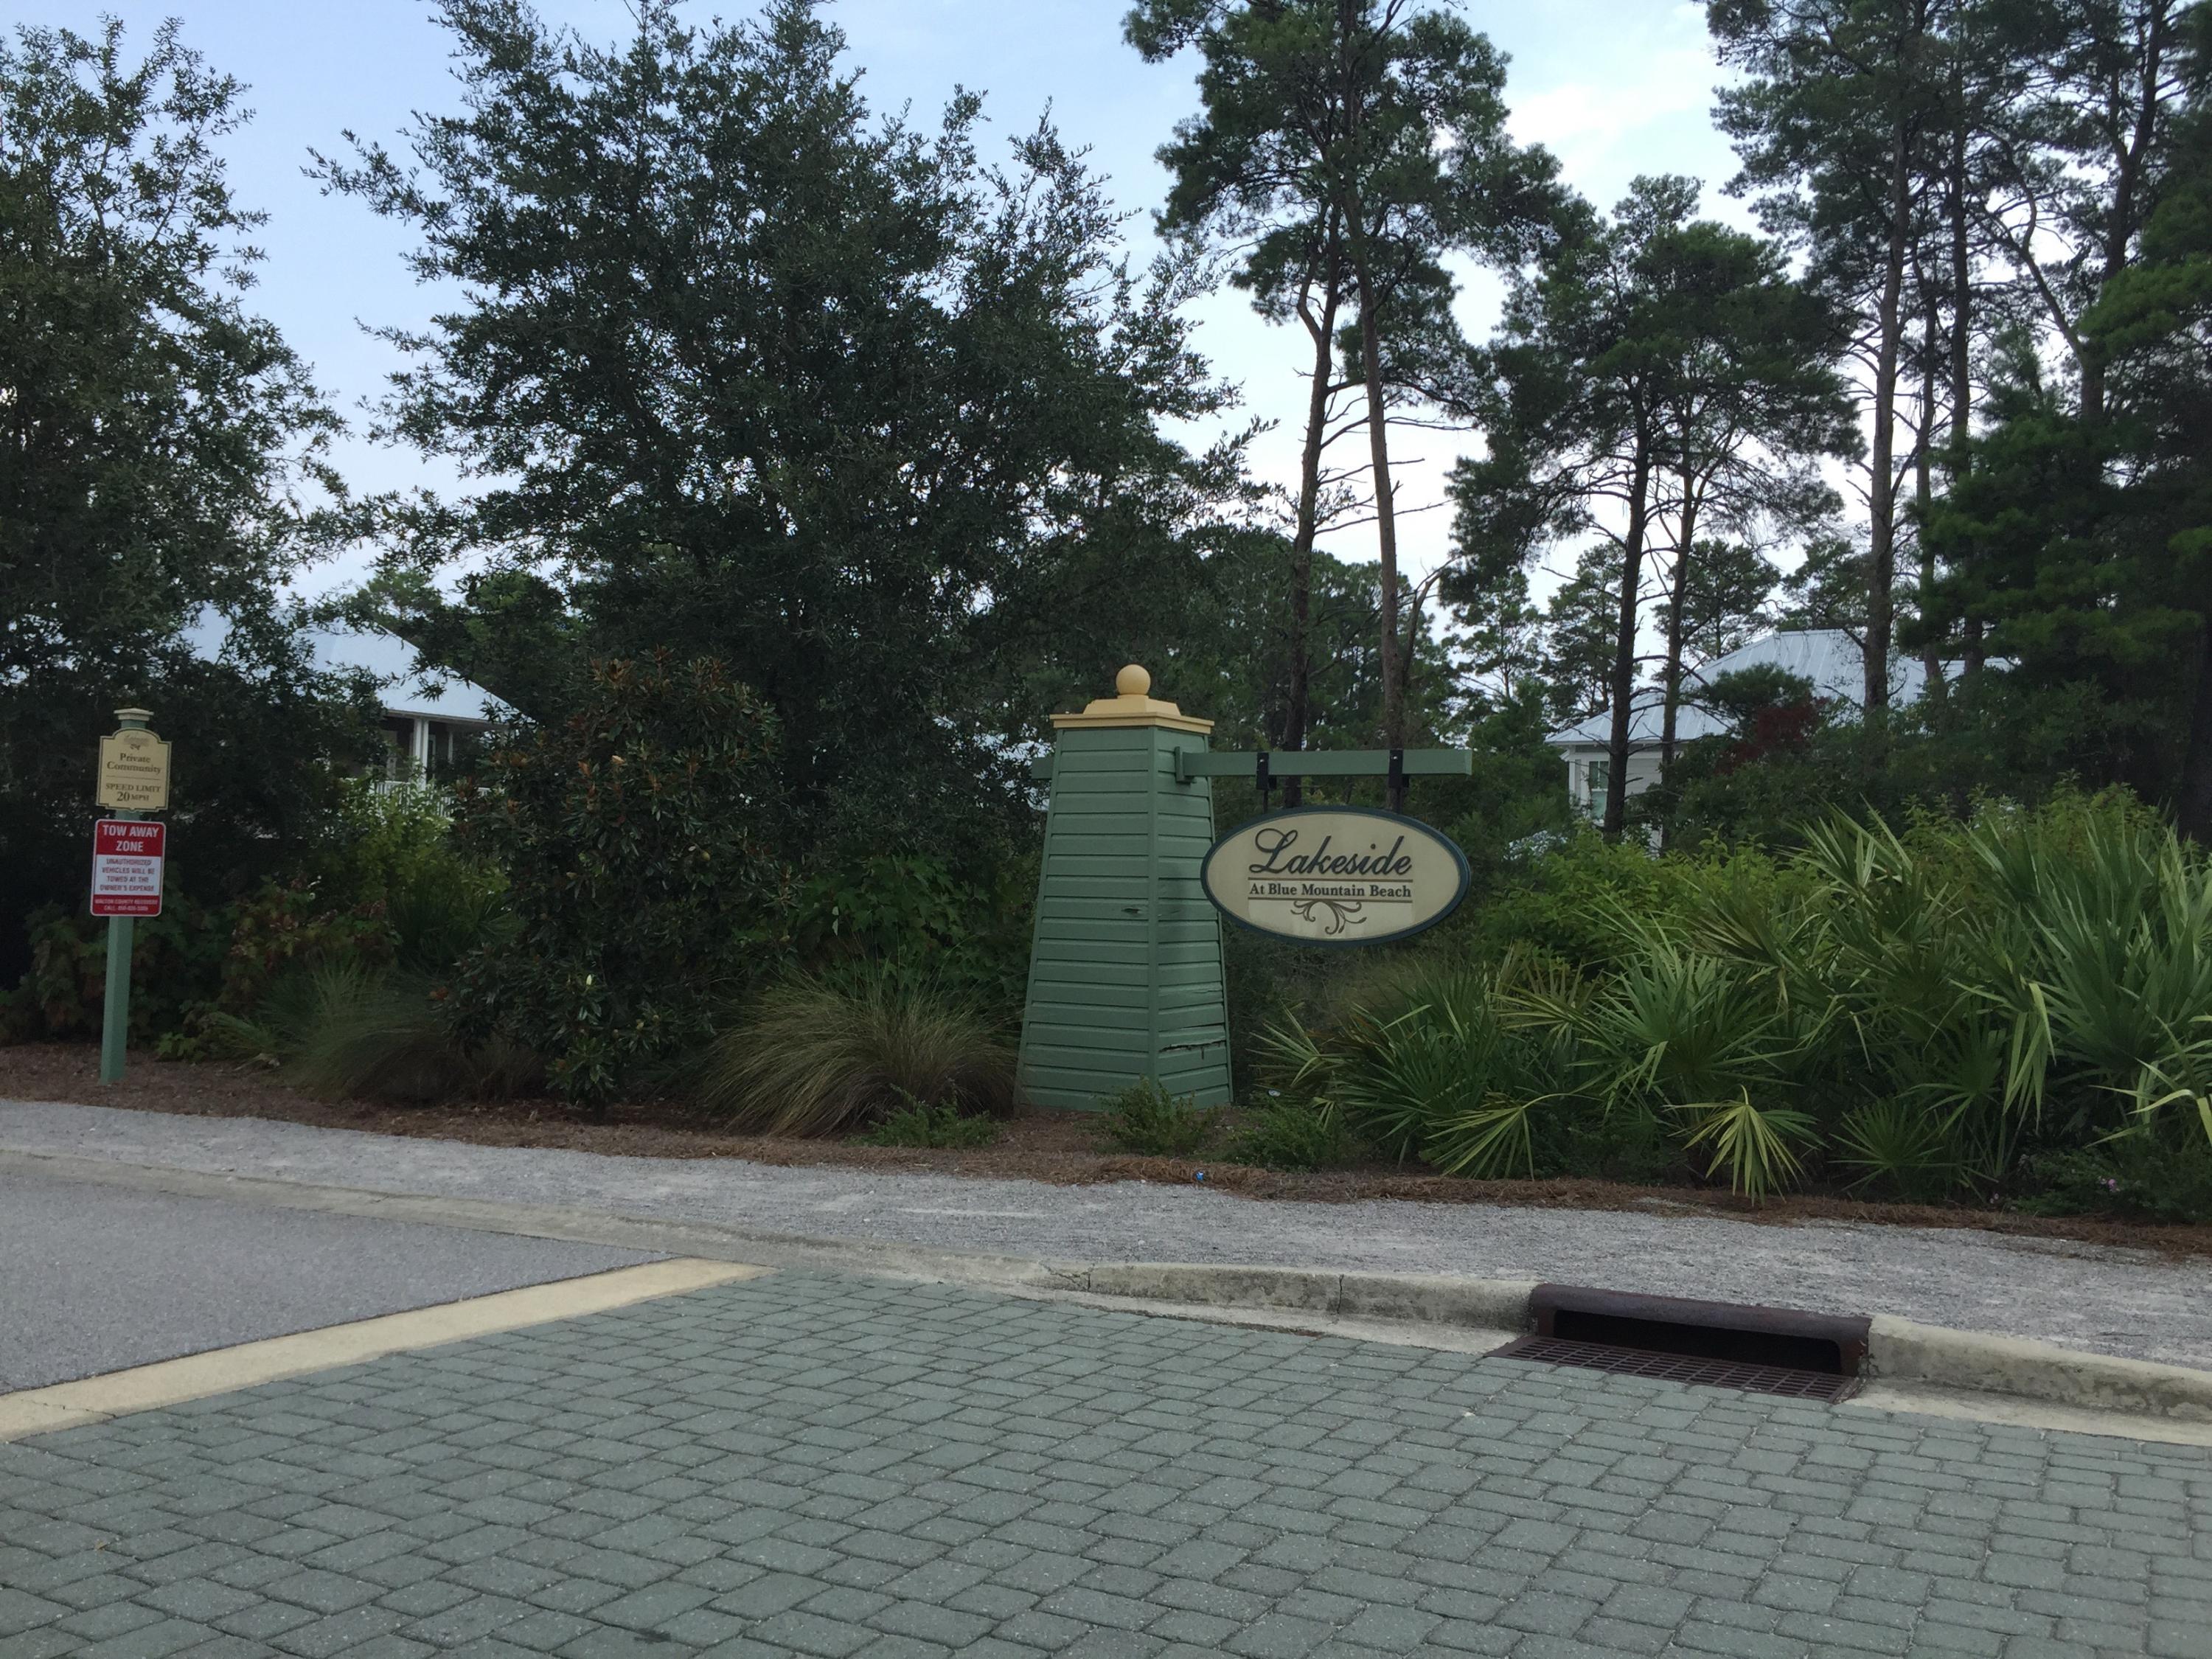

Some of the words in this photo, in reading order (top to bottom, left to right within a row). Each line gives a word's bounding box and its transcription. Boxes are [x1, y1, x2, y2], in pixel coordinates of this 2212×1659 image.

[120, 753, 151, 763] Private
[107, 761, 161, 775] Community
[105, 783, 134, 791] SPEED
[136, 785, 161, 793] LIMIT
[116, 791, 131, 801] 20
[102, 825, 127, 836] TOW
[129, 827, 159, 838] AWAY
[115, 841, 144, 852] ZONE
[1248, 827, 1413, 876] Lakeside
[1249, 883, 1265, 895] At
[1268, 883, 1297, 896] Blue
[1301, 884, 1365, 897] Mountain
[1370, 885, 1412, 898] Beach
